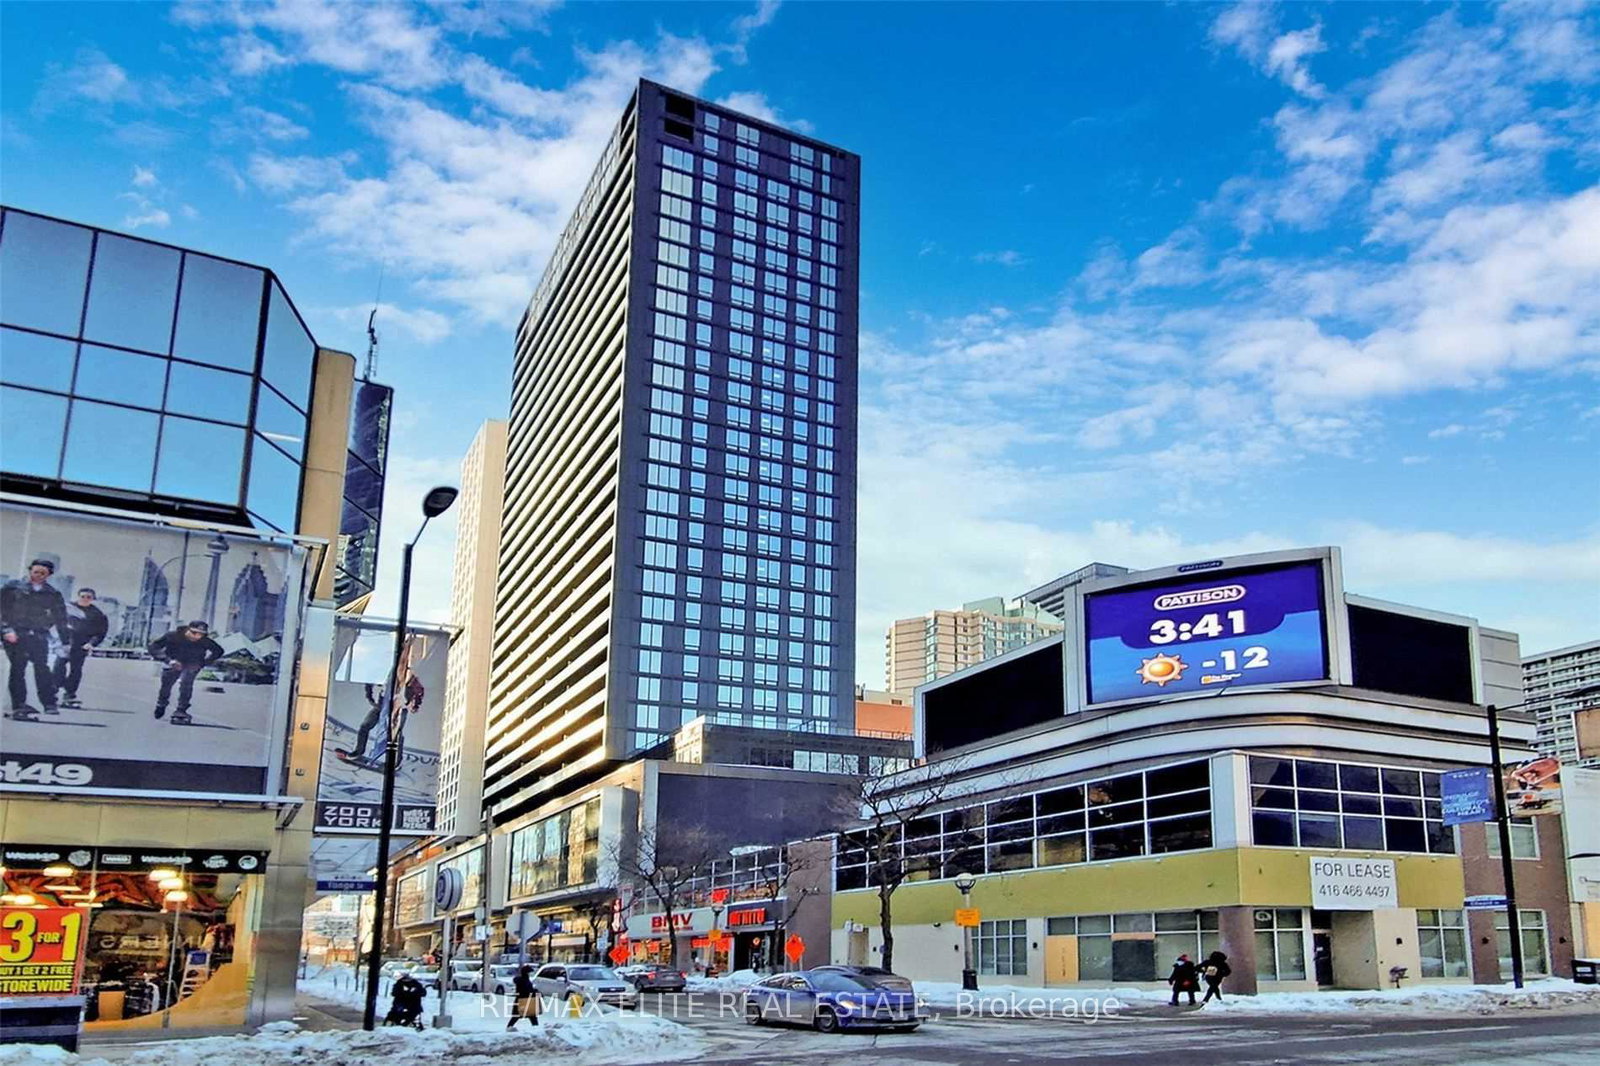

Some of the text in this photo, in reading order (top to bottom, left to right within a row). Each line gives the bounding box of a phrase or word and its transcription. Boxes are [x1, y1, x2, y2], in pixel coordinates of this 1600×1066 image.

[1161, 588, 1238, 607] PATTISON
[1149, 609, 1246, 645] 3:41
[1202, 646, 1270, 671] -12
[0, 761, 93, 786] t49
[324, 806, 372, 817] ZOO
[324, 816, 382, 828] YORK
[1314, 862, 1391, 879] FOR LEASE
[1319, 885, 1340, 897] 416
[652, 912, 694, 928] BMV
[0, 911, 82, 962] 3 FOR 1
[23, 967, 40, 975] GET
[42, 967, 49, 975] 2
[50, 966, 74, 975] FREE
[0, 980, 72, 993] TOREWIDE
